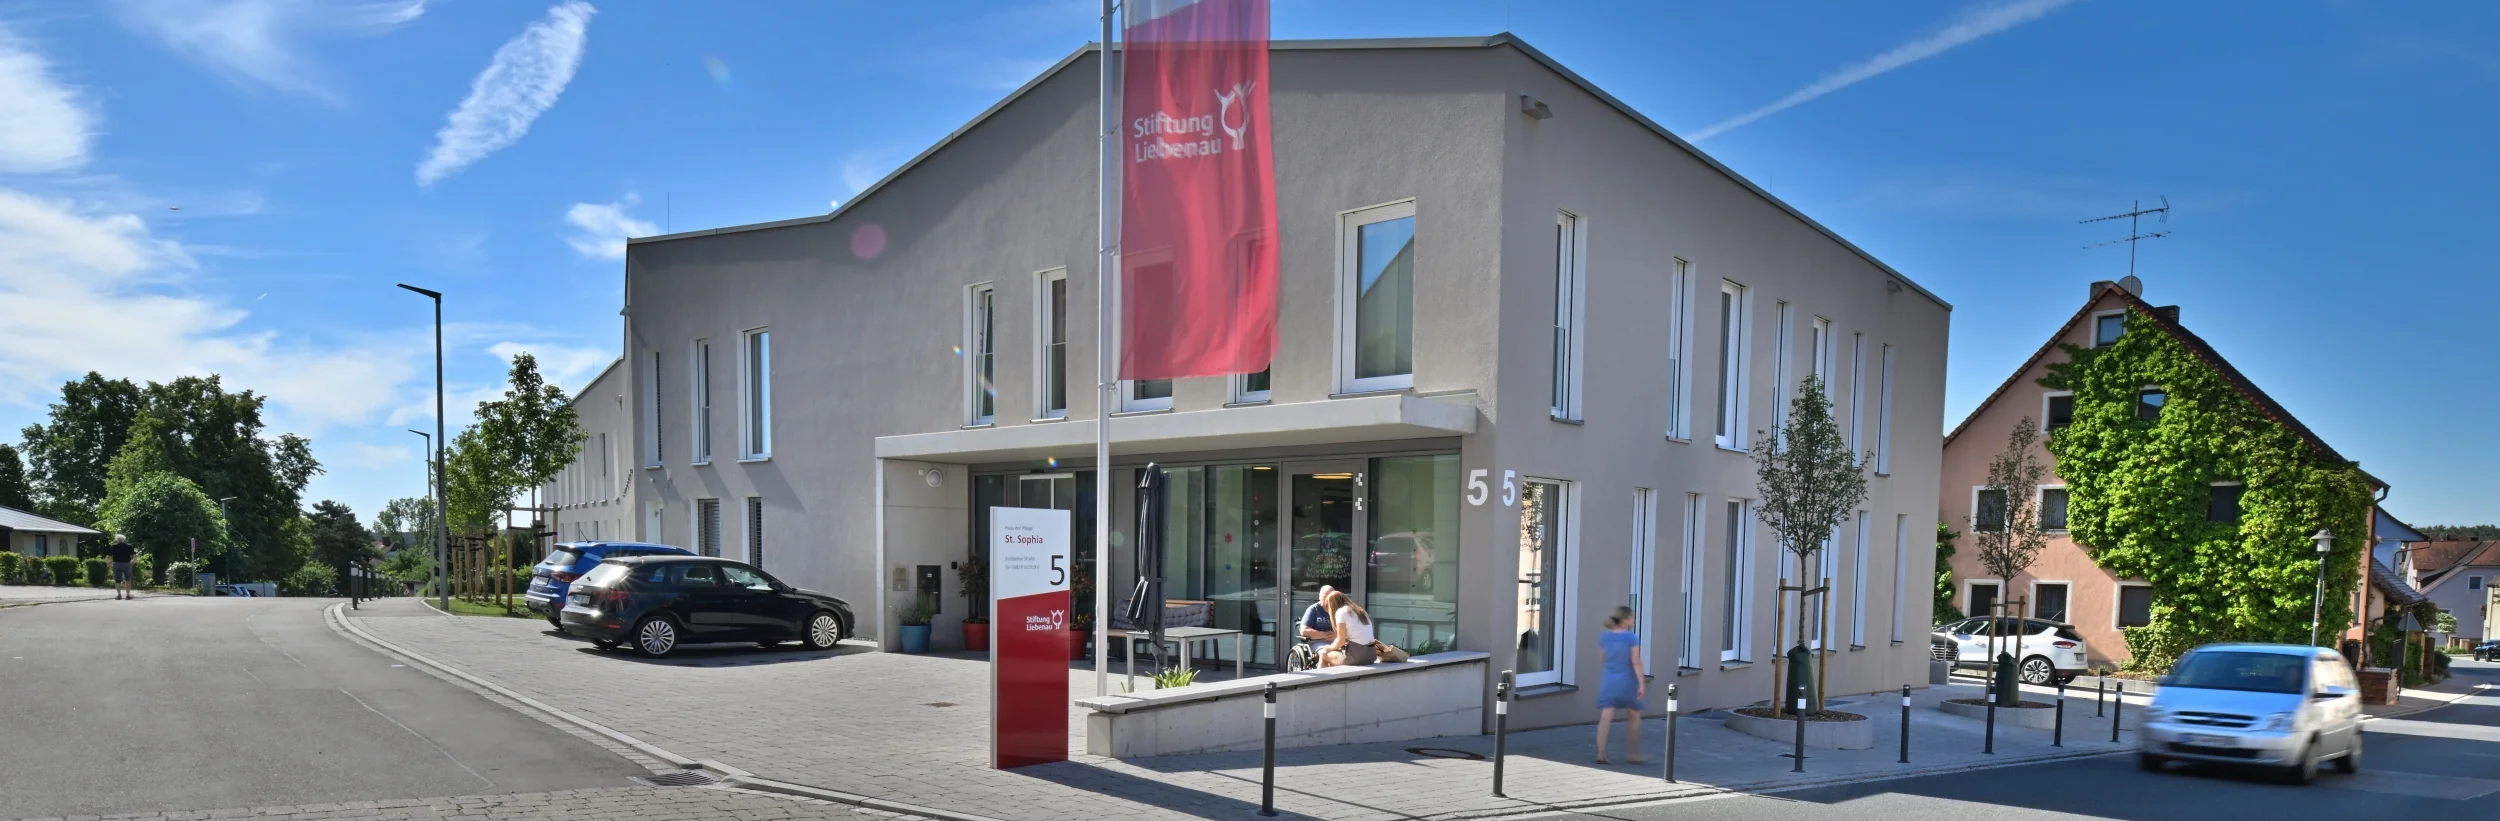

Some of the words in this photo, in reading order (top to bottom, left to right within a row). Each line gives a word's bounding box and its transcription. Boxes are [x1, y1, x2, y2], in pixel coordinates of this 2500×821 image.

[1133, 110, 1214, 138] Stiftung
[1134, 136, 1222, 163] Liebenau
[1466, 468, 1489, 506] 5
[1502, 469, 1516, 507] 5
[1004, 534, 1015, 544] St.
[1017, 534, 1043, 545] Sophia
[1049, 554, 1065, 586] 5
[1026, 615, 1050, 624] Stiftung
[1026, 623, 1053, 631] Liebenau
